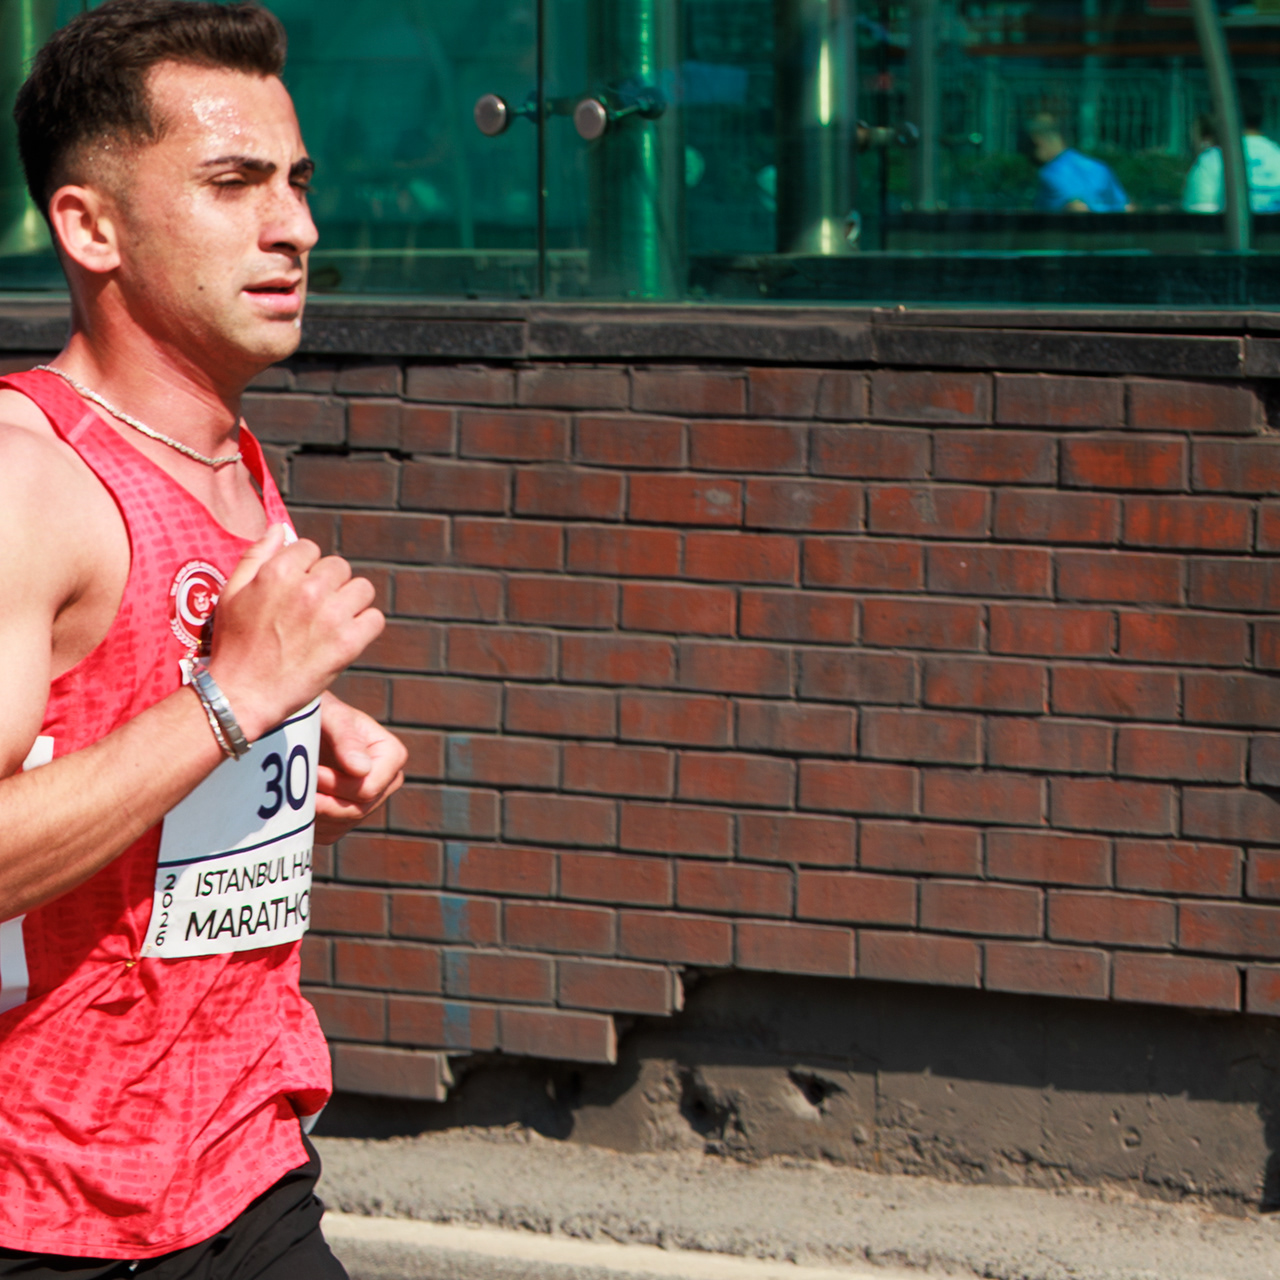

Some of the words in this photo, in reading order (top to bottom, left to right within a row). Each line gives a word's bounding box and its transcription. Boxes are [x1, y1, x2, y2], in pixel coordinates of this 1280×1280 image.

[257, 744, 310, 820] 30
[195, 856, 289, 897] ISTANBUL
[292, 848, 312, 879] HA
[155, 873, 177, 946] 2026
[185, 889, 310, 941] MARATHO
